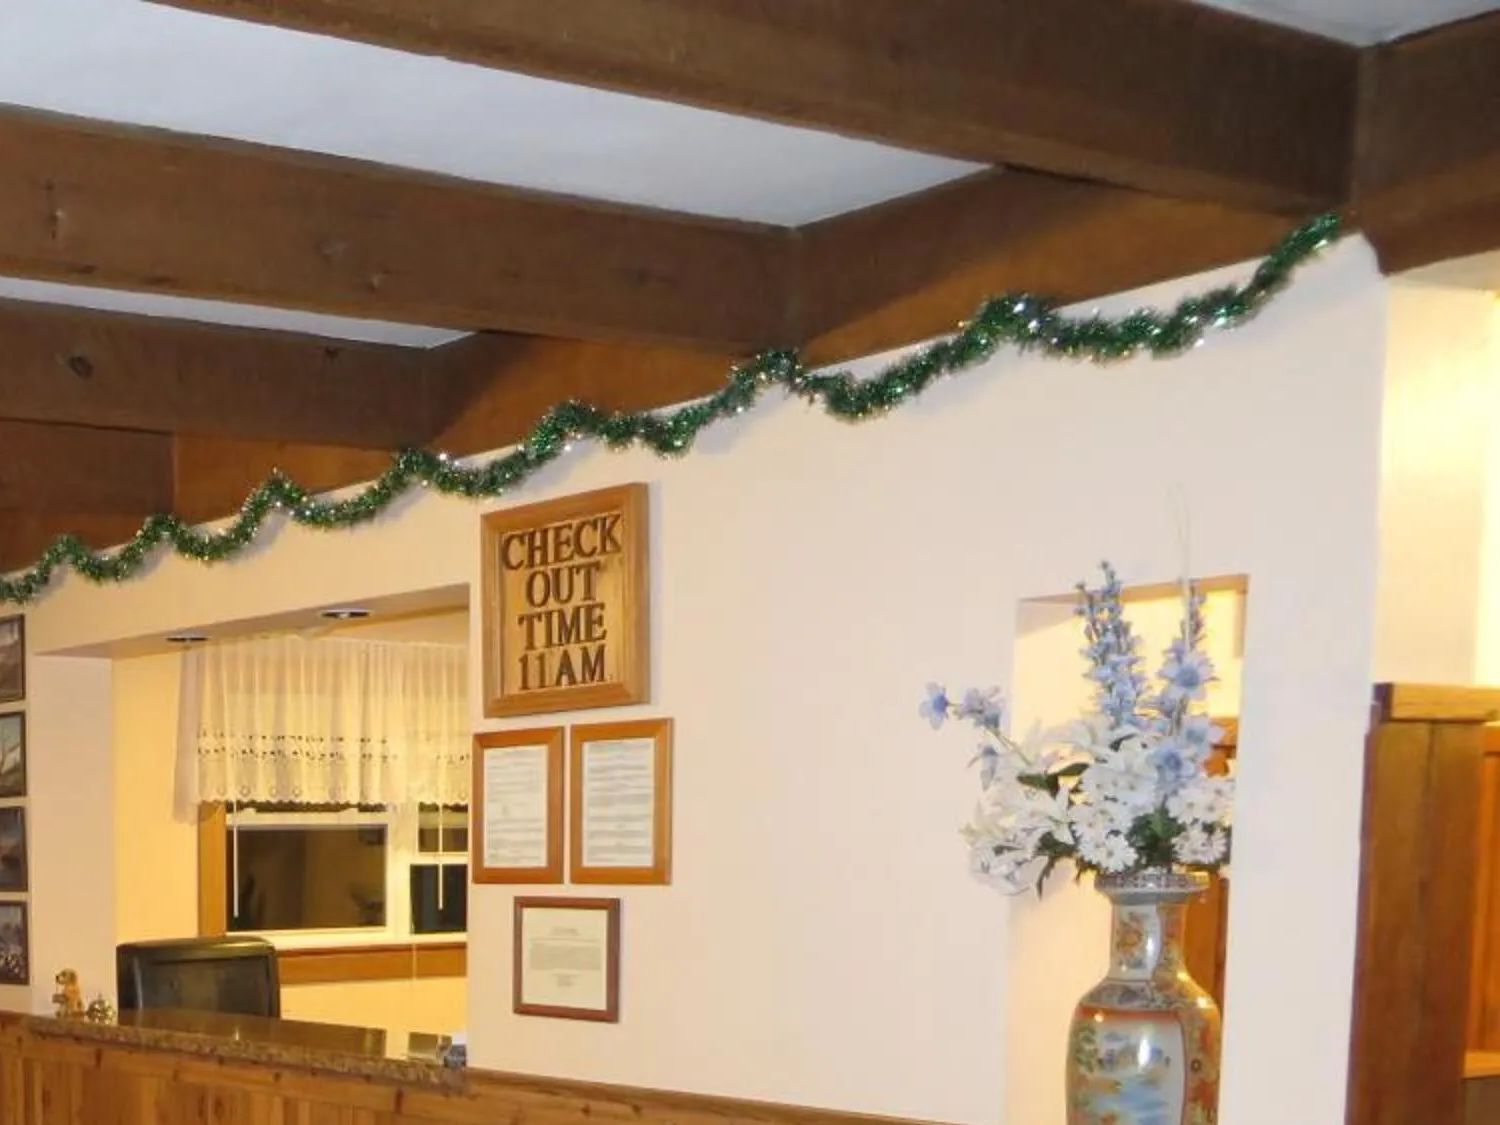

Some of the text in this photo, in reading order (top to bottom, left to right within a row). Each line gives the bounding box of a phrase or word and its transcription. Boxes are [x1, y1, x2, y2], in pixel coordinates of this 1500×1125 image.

[504, 514, 621, 570] CHECK
[527, 561, 601, 607] OUT
[518, 603, 607, 650] TIME
[518, 645, 606, 690] 11AM
